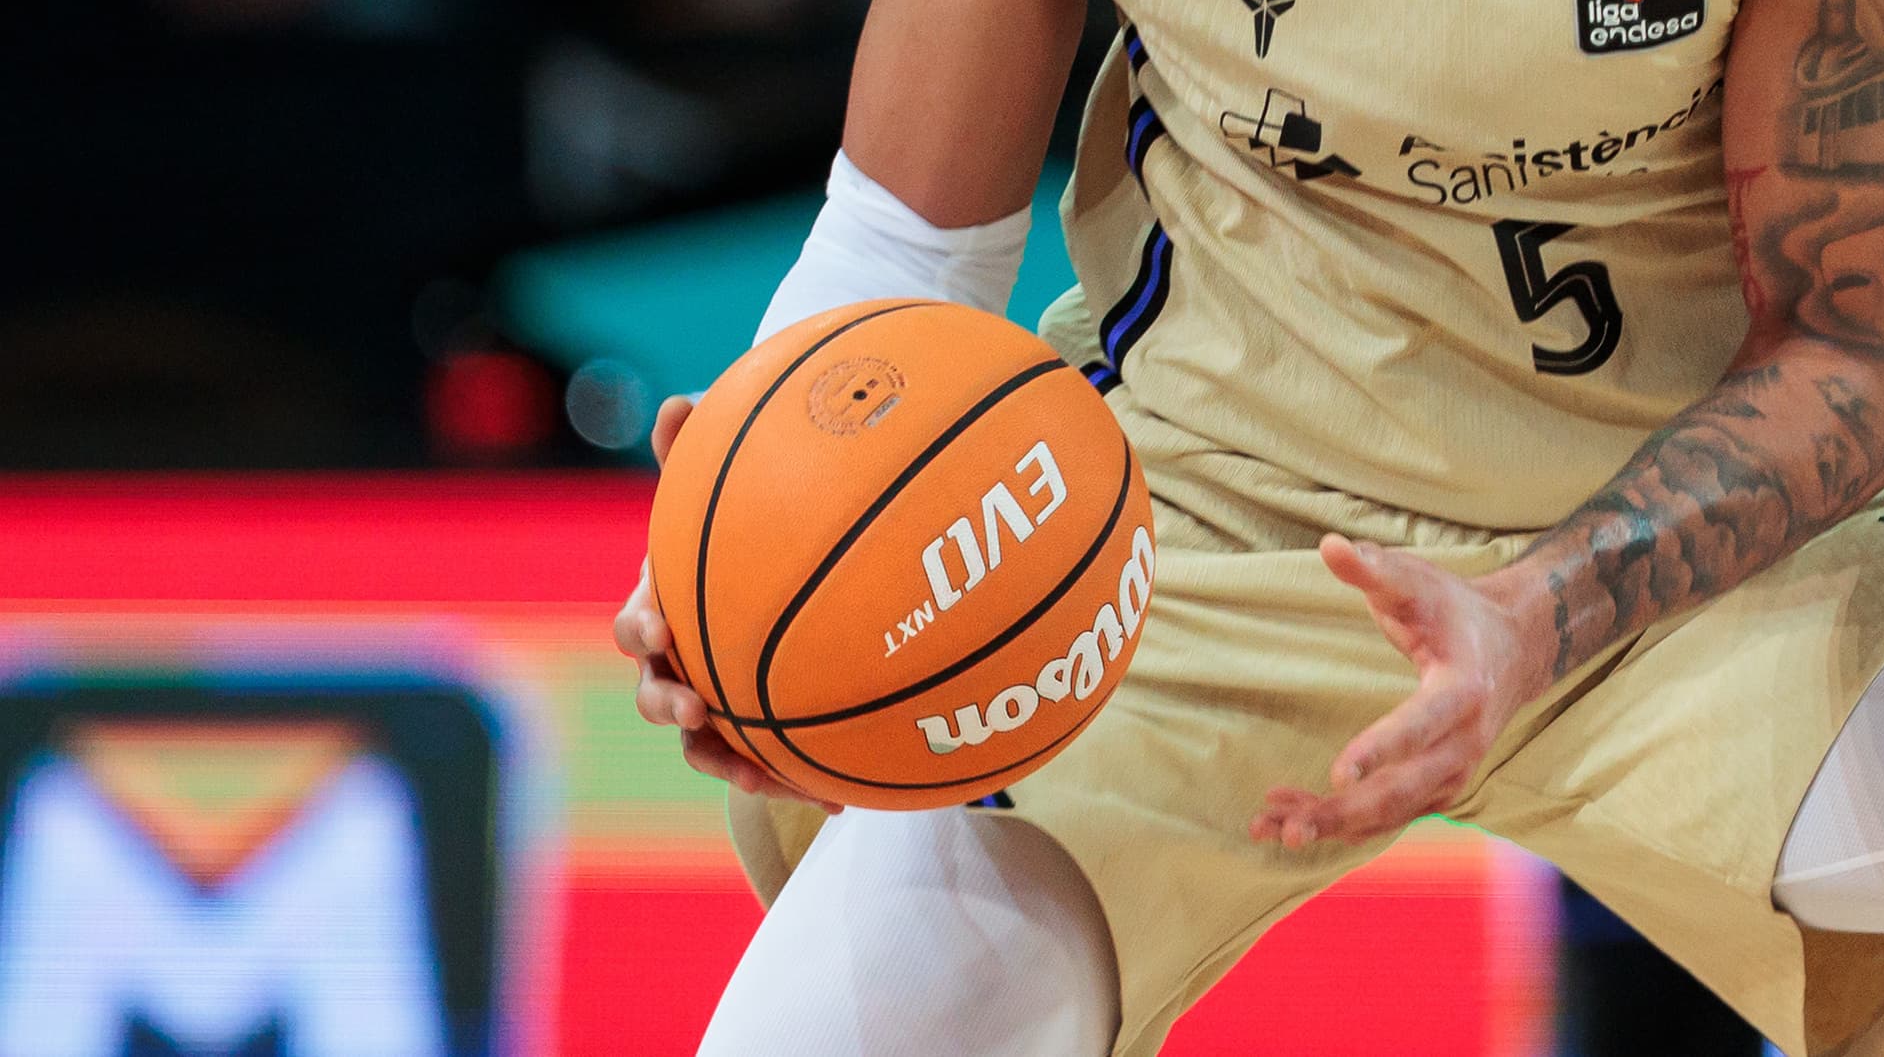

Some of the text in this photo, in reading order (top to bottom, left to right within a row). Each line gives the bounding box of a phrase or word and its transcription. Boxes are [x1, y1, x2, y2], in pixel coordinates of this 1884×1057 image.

[1589, 19, 1699, 47] endesa
[1492, 218, 1623, 376] 5
[884, 599, 935, 658] NXT
